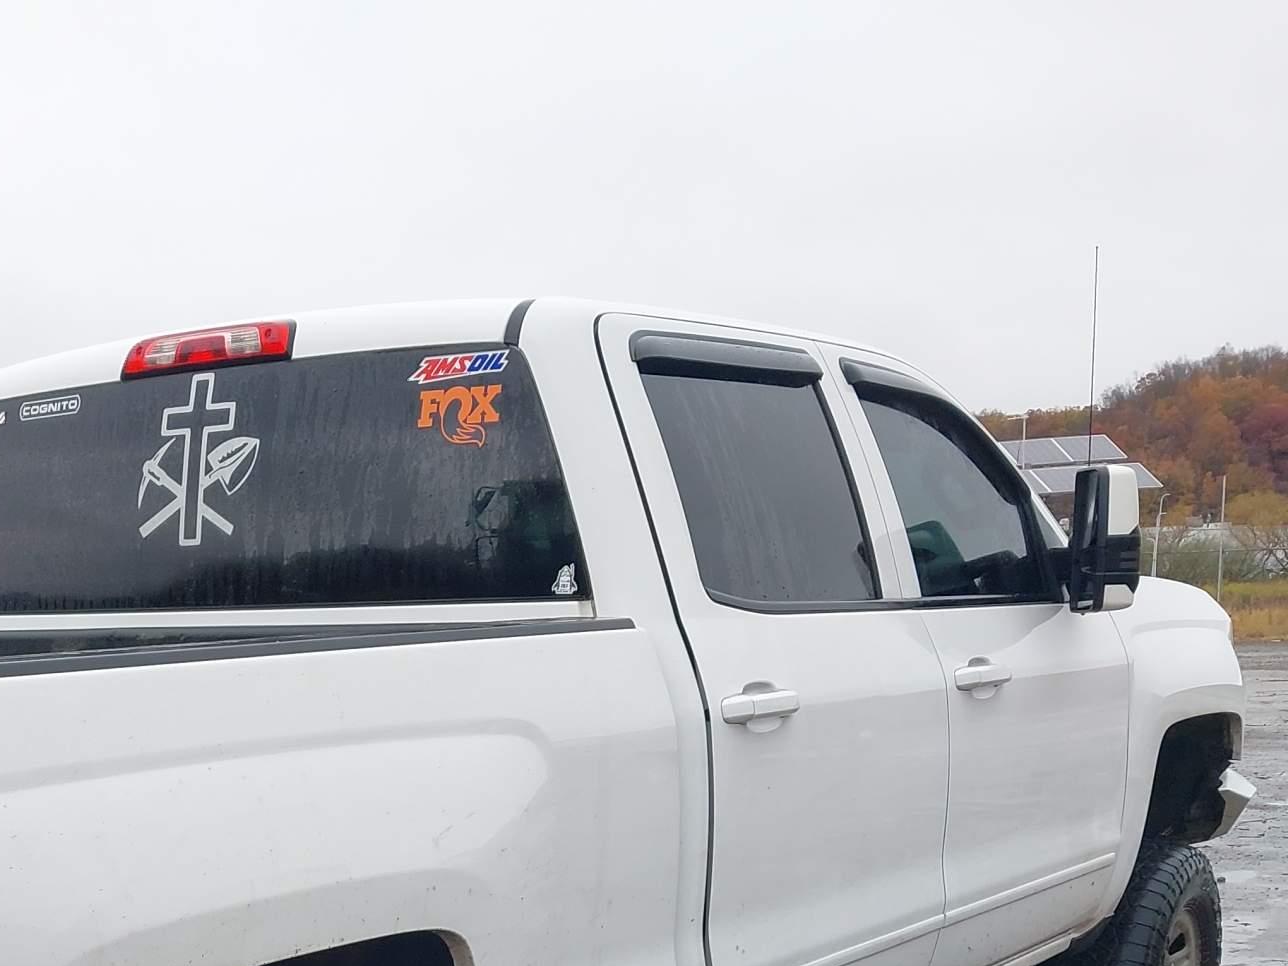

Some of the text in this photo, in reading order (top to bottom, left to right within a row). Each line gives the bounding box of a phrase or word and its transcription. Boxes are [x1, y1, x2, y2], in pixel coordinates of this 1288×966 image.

[412, 351, 508, 382] AMSOIL
[22, 399, 79, 417] COGNITO
[417, 384, 502, 447] FOX
